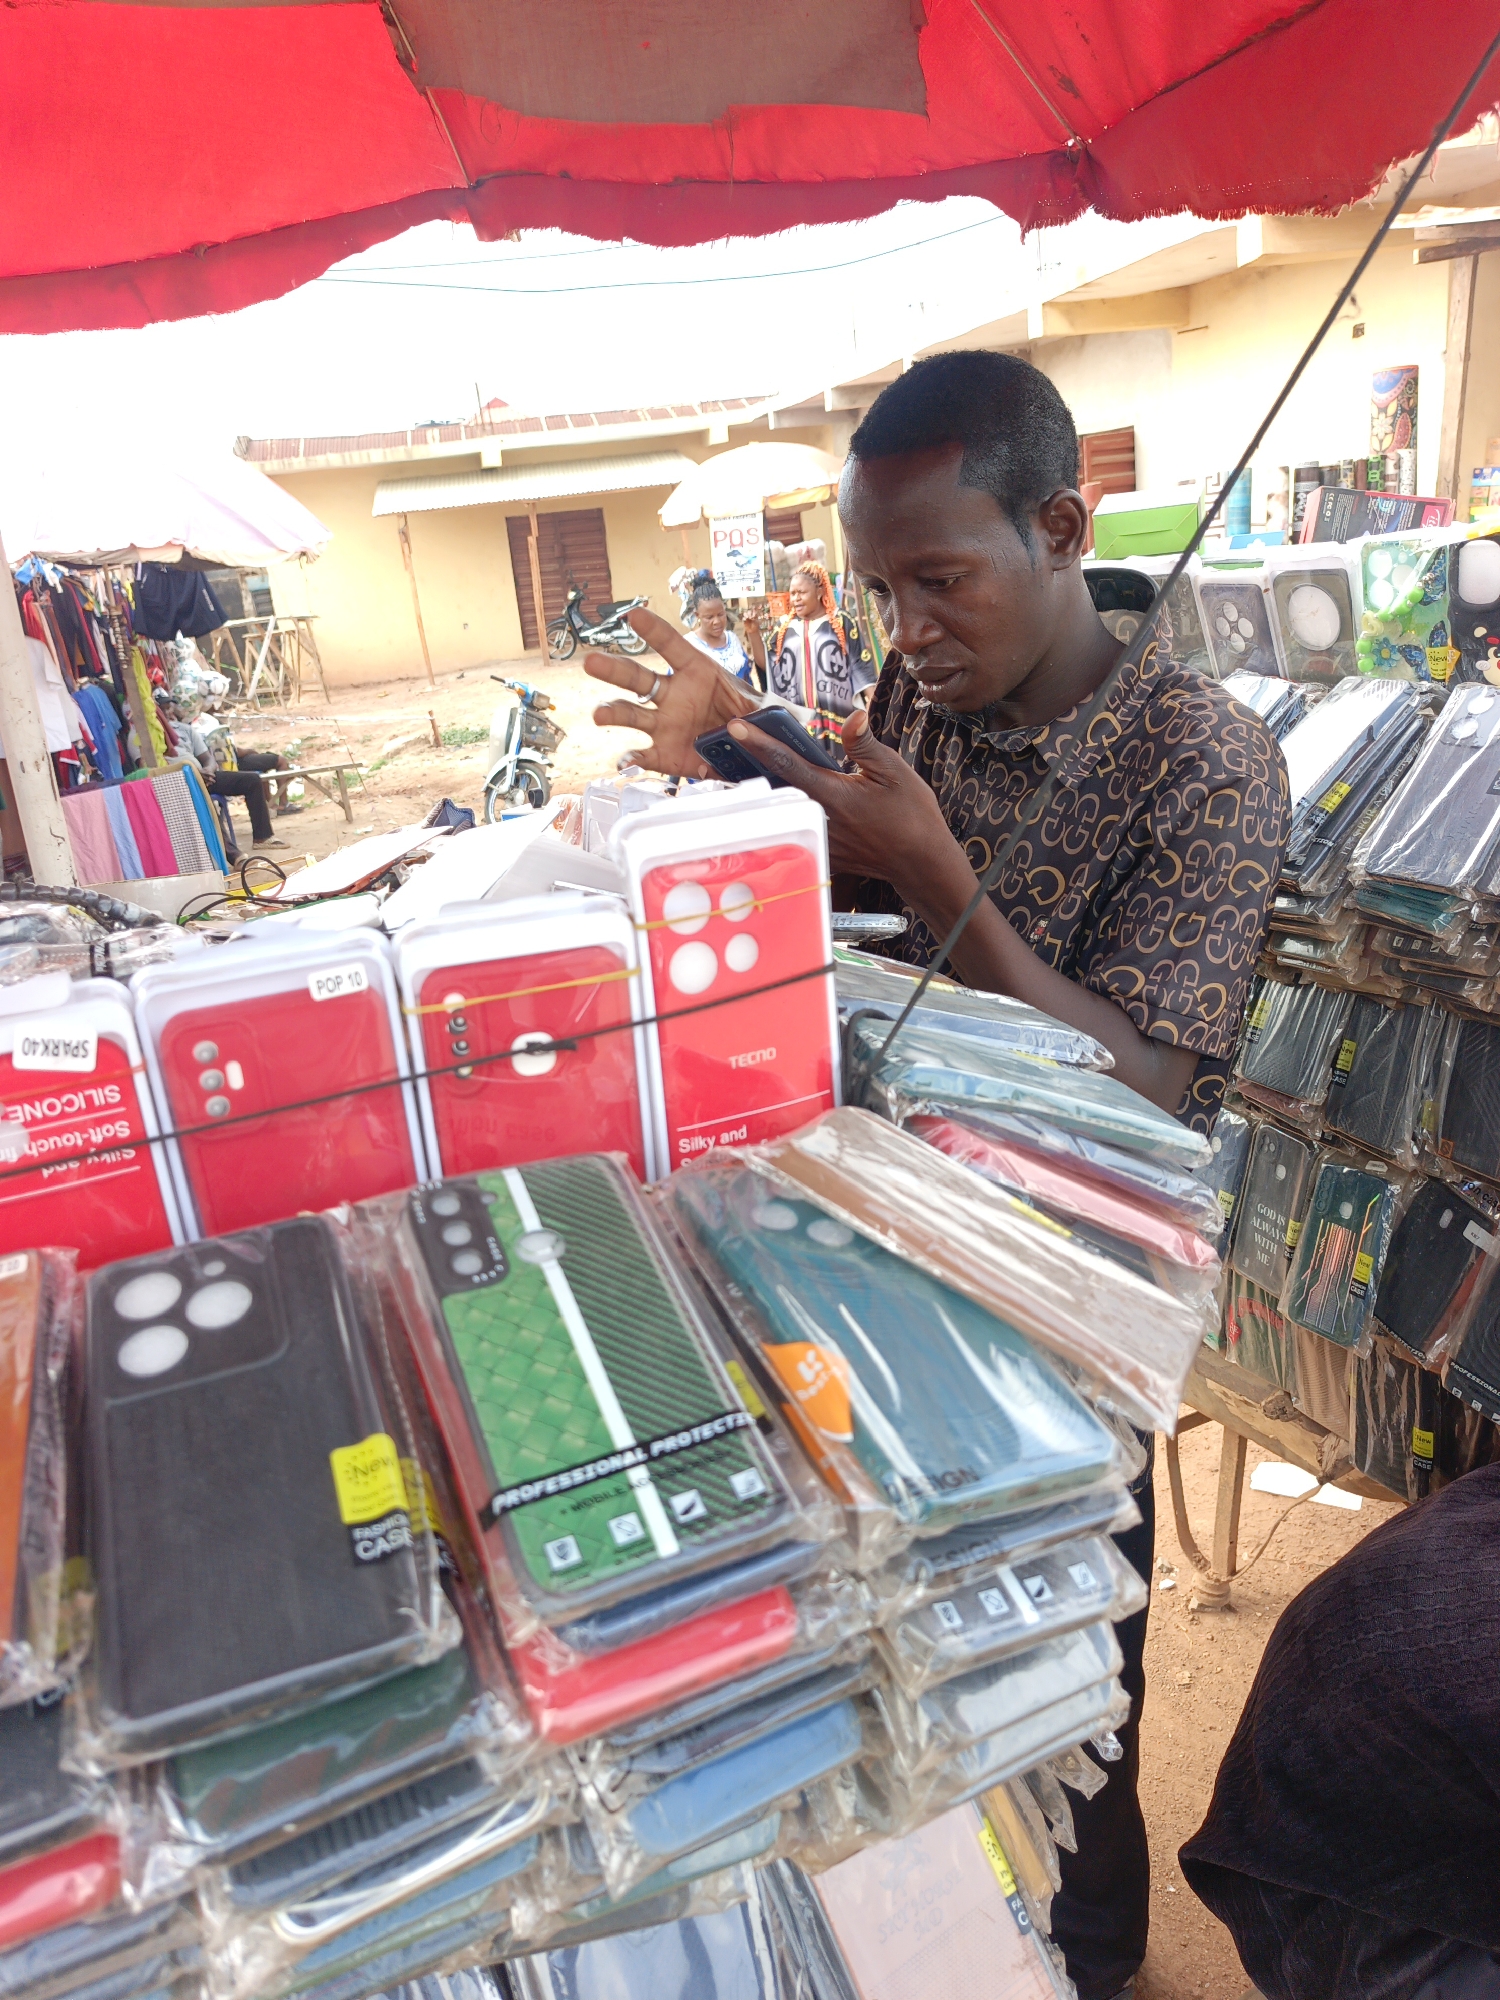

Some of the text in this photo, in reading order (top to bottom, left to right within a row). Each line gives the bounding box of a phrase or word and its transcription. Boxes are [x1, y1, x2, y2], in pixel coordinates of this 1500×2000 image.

[713, 527, 760, 550] POS
[816, 679, 849, 700] GUCCI
[315, 970, 363, 996] POP 10
[22, 1036, 91, 1059] SPARK40
[728, 1047, 777, 1070] TECNO
[1340, 1045, 1354, 1056] New
[5, 1084, 122, 1125] SILICONE
[24, 1120, 131, 1158] Soft-touch
[678, 1123, 748, 1154] Silky and
[1220, 1196, 1233, 1206] New
[1257, 1203, 1287, 1226] GOD IS
[1250, 1216, 1287, 1244] ALWAYS
[1254, 1232, 1278, 1255] WITH
[1256, 1250, 1271, 1266] ME
[1358, 1257, 1371, 1269] New
[1350, 1285, 1365, 1297] CASE
[1416, 1434, 1432, 1445] New
[1413, 1460, 1432, 1470] CASE
[491, 1447, 649, 1516] PROFESSIONAL
[570, 1486, 627, 1512] MOBILE
